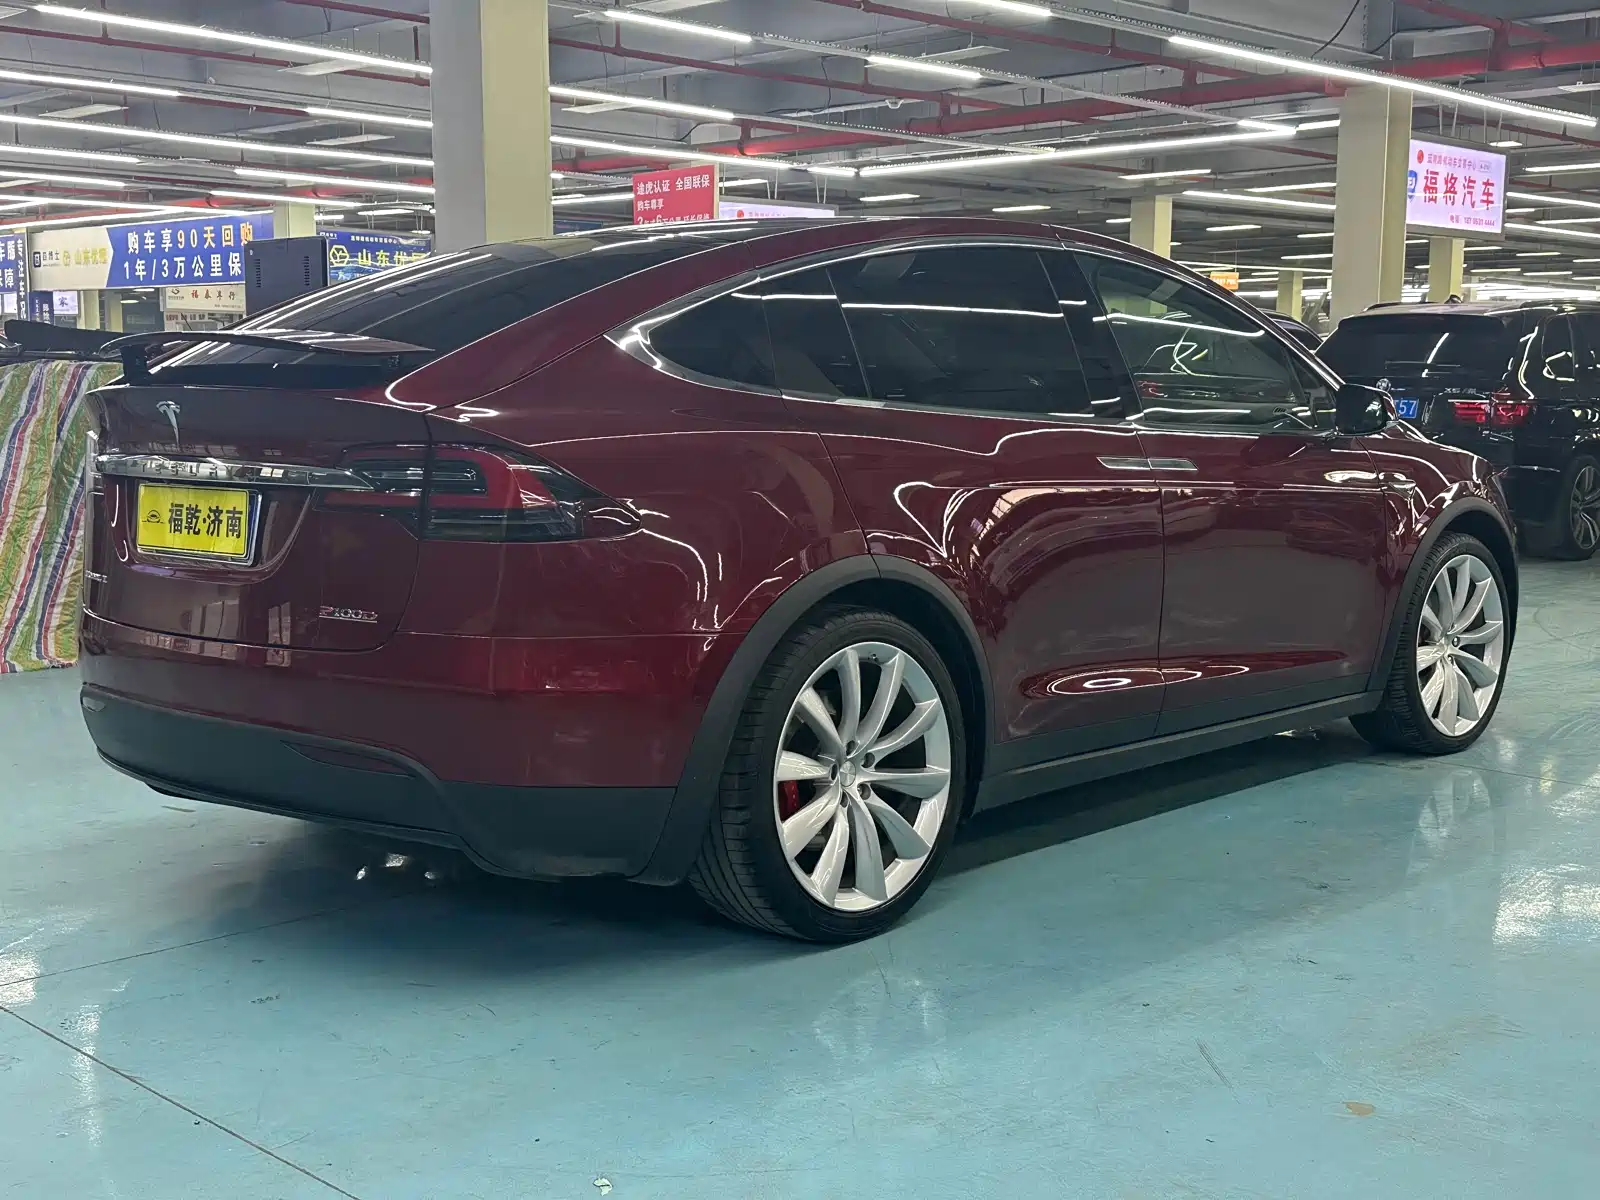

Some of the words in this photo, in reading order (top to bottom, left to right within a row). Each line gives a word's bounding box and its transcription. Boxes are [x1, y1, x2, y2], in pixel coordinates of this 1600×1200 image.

[637, 179, 671, 196] 途虎认证
[675, 174, 710, 191] 全国联保
[1423, 169, 1495, 210] 福将汽车
[123, 252, 242, 281] 1年/3万公里保
[1395, 400, 1417, 416] 57
[168, 502, 243, 539] 福乾·济南
[319, 605, 378, 621] P100D
